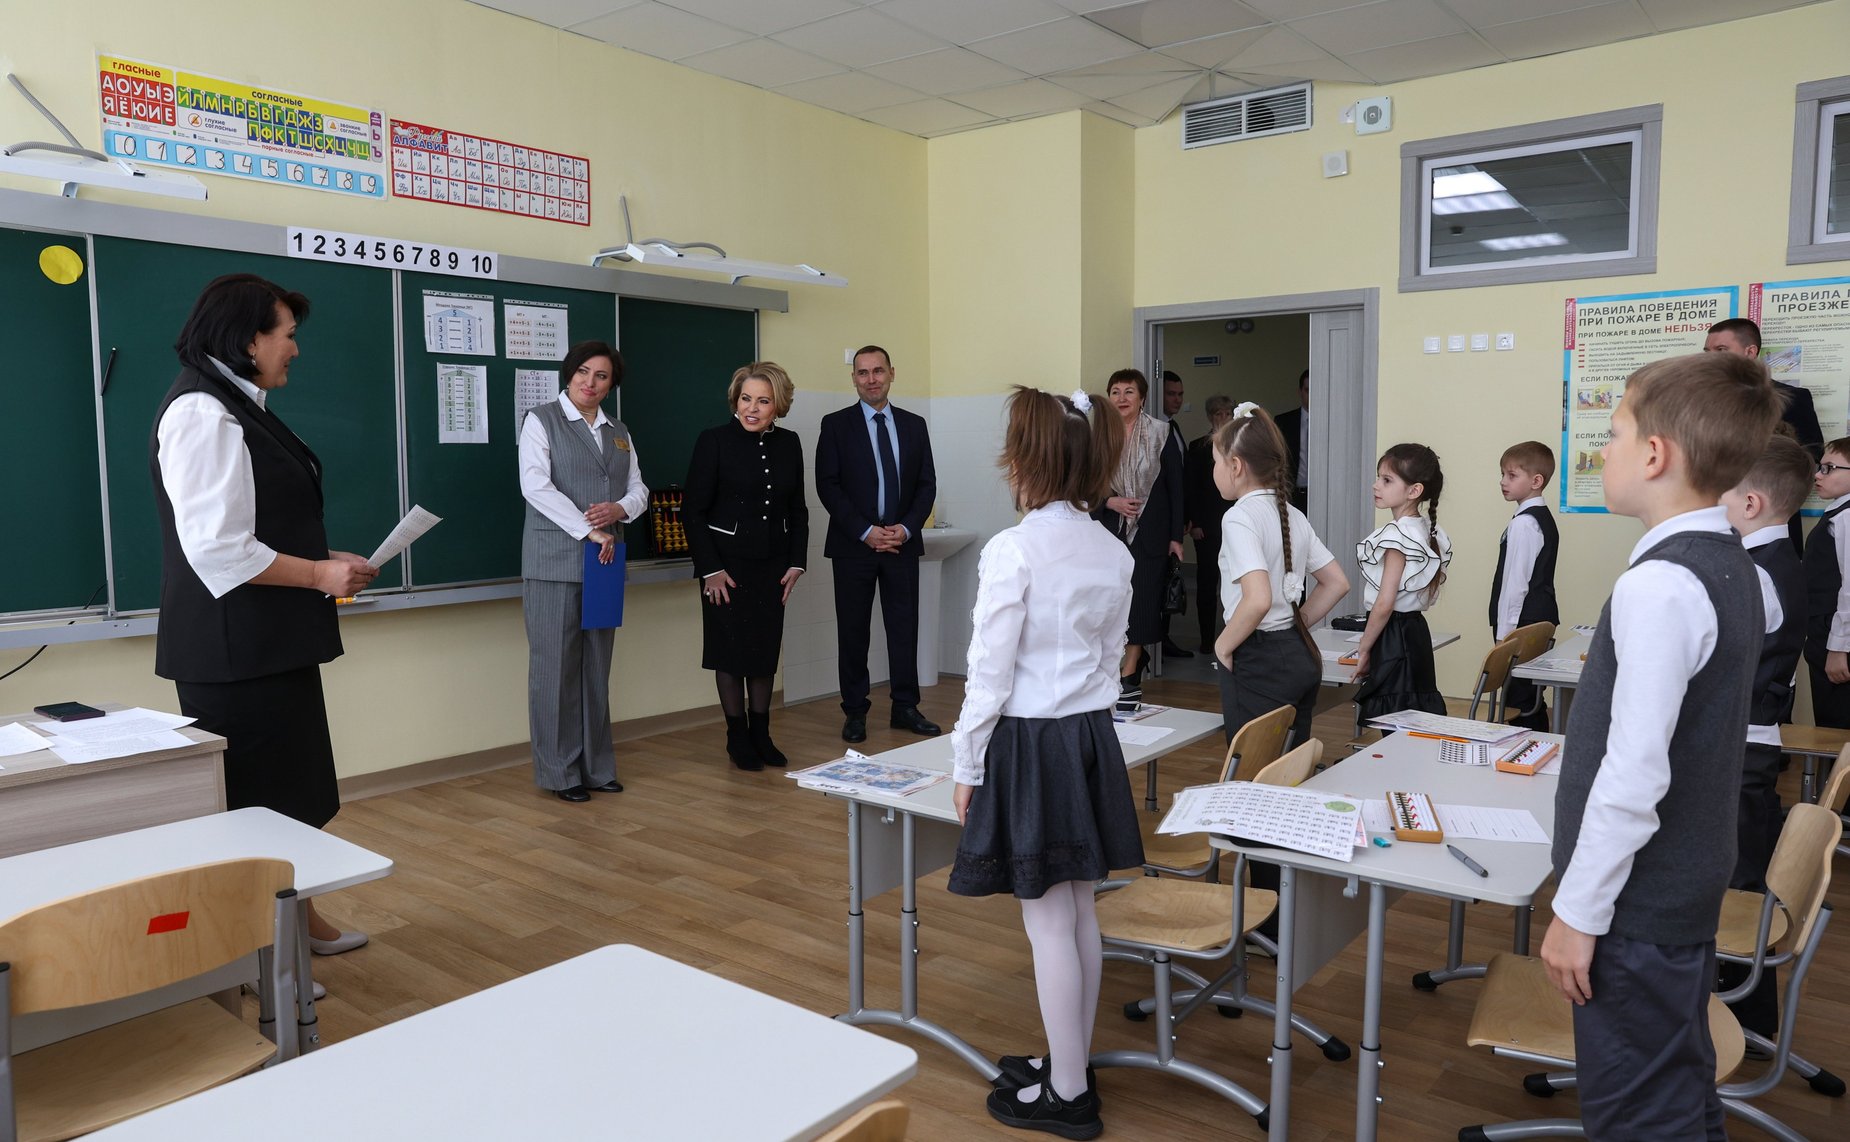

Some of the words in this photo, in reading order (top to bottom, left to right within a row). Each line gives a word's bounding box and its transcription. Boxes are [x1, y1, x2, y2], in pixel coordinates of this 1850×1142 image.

[113, 62, 161, 78] гласные
[252, 91, 303, 107] согласные
[394, 135, 448, 153] АЛФАВИТ
[293, 232, 302, 252] 1
[314, 234, 326, 254] 2
[334, 238, 346, 257] 3
[354, 240, 366, 259] 4
[374, 242, 386, 260] 5
[393, 244, 404, 263] 6
[412, 246, 423, 264] 7
[430, 249, 440, 267] 8
[448, 252, 458, 270] 9
[472, 255, 492, 274] 10
[1772, 290, 1840, 302] ПРАВИЛА
[1579, 304, 1634, 316] ПРАВИЛА
[1639, 299, 1717, 312] ПОВЕДЕНИЯ
[1778, 300, 1849, 313] ПРОЕЗЖЕ
[1579, 317, 1602, 326] ПРИ
[1608, 314, 1661, 324] ПОЖАРЕ
[1666, 312, 1674, 321] В
[1679, 310, 1716, 321] ДОМЕ
[1596, 329, 1628, 338] ПОЖАРЕ
[1639, 328, 1662, 336] ДОМЕ
[1665, 323, 1712, 334] НЕЛЬЗЯ
